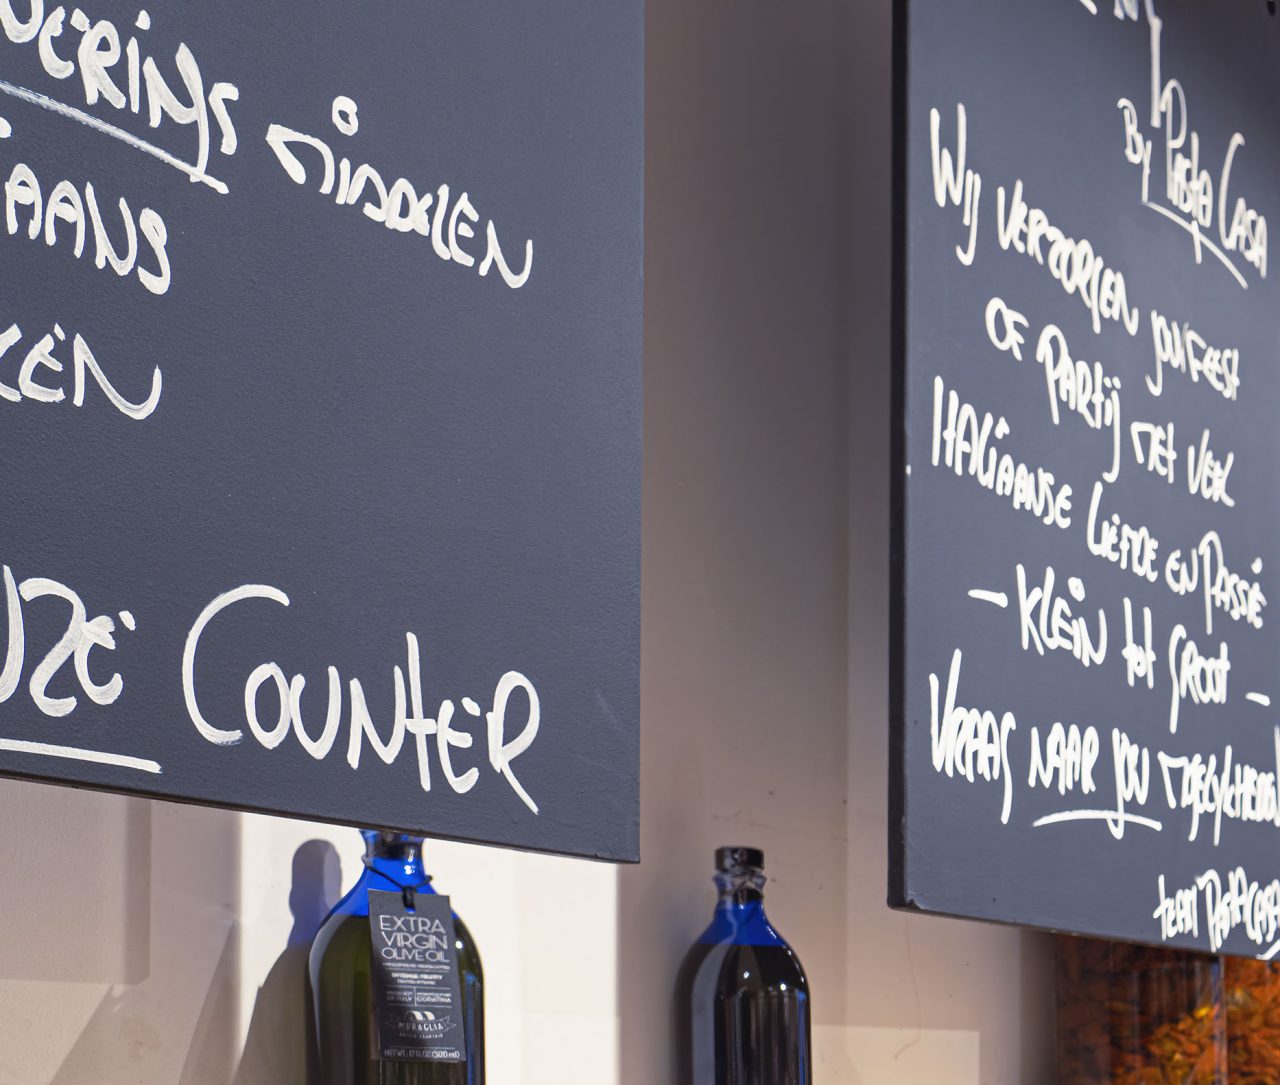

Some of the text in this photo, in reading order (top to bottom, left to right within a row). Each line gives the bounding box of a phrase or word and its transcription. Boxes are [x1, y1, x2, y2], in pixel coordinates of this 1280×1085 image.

[0, 116, 170, 294] AANS
[379, 915, 446, 933] EXTRA
[382, 931, 448, 949] VIRGIN
[382, 947, 450, 962] OLIVE OIL
